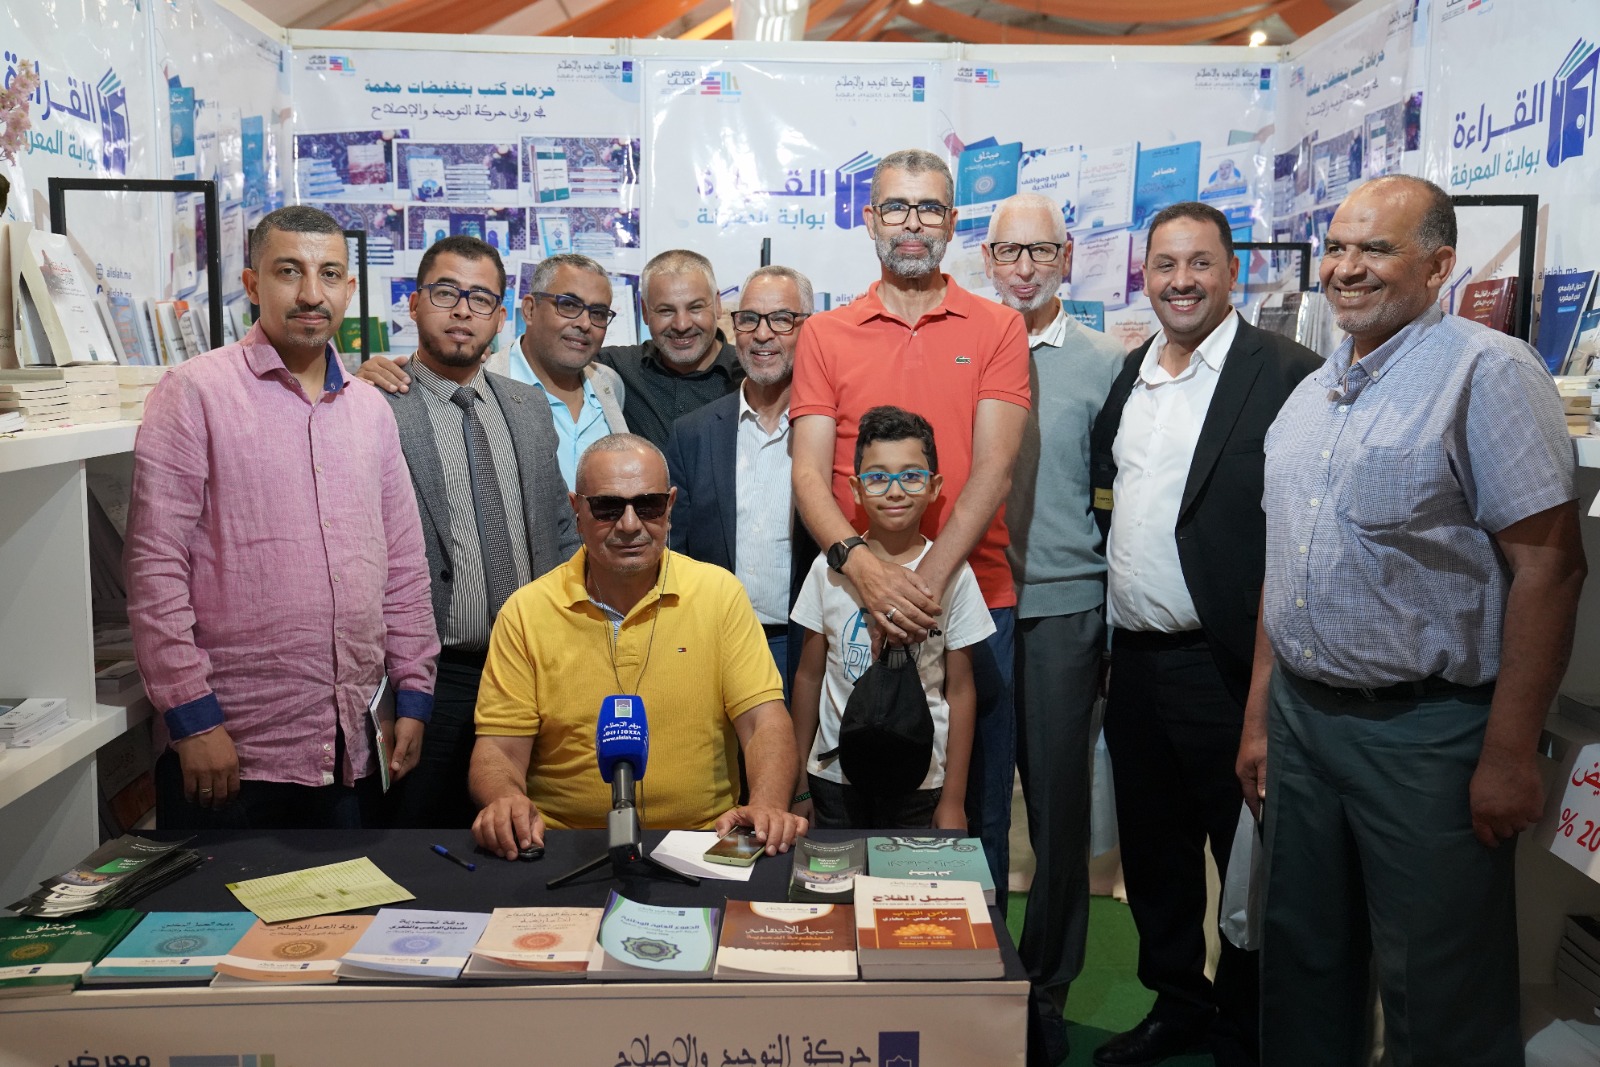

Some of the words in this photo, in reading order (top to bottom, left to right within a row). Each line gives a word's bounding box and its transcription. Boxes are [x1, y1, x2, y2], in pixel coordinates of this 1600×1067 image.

[5, 51, 96, 124] القراة
[365, 79, 402, 93] مهمة
[408, 80, 473, 98] بتخفيضات
[477, 82, 507, 98] كتب
[512, 83, 556, 99] حزمات
[371, 103, 429, 120] والإصلاح
[432, 104, 471, 120] التوحيد
[475, 104, 506, 121] حركة
[509, 106, 531, 122] رواق
[534, 106, 546, 118] في
[1453, 80, 1546, 154] القراءة
[1505, 145, 1540, 179] بوابة
[1450, 152, 1501, 190] المعرفة
[778, 208, 826, 230] بوابة
[26, 923, 76, 933] ميثاق
